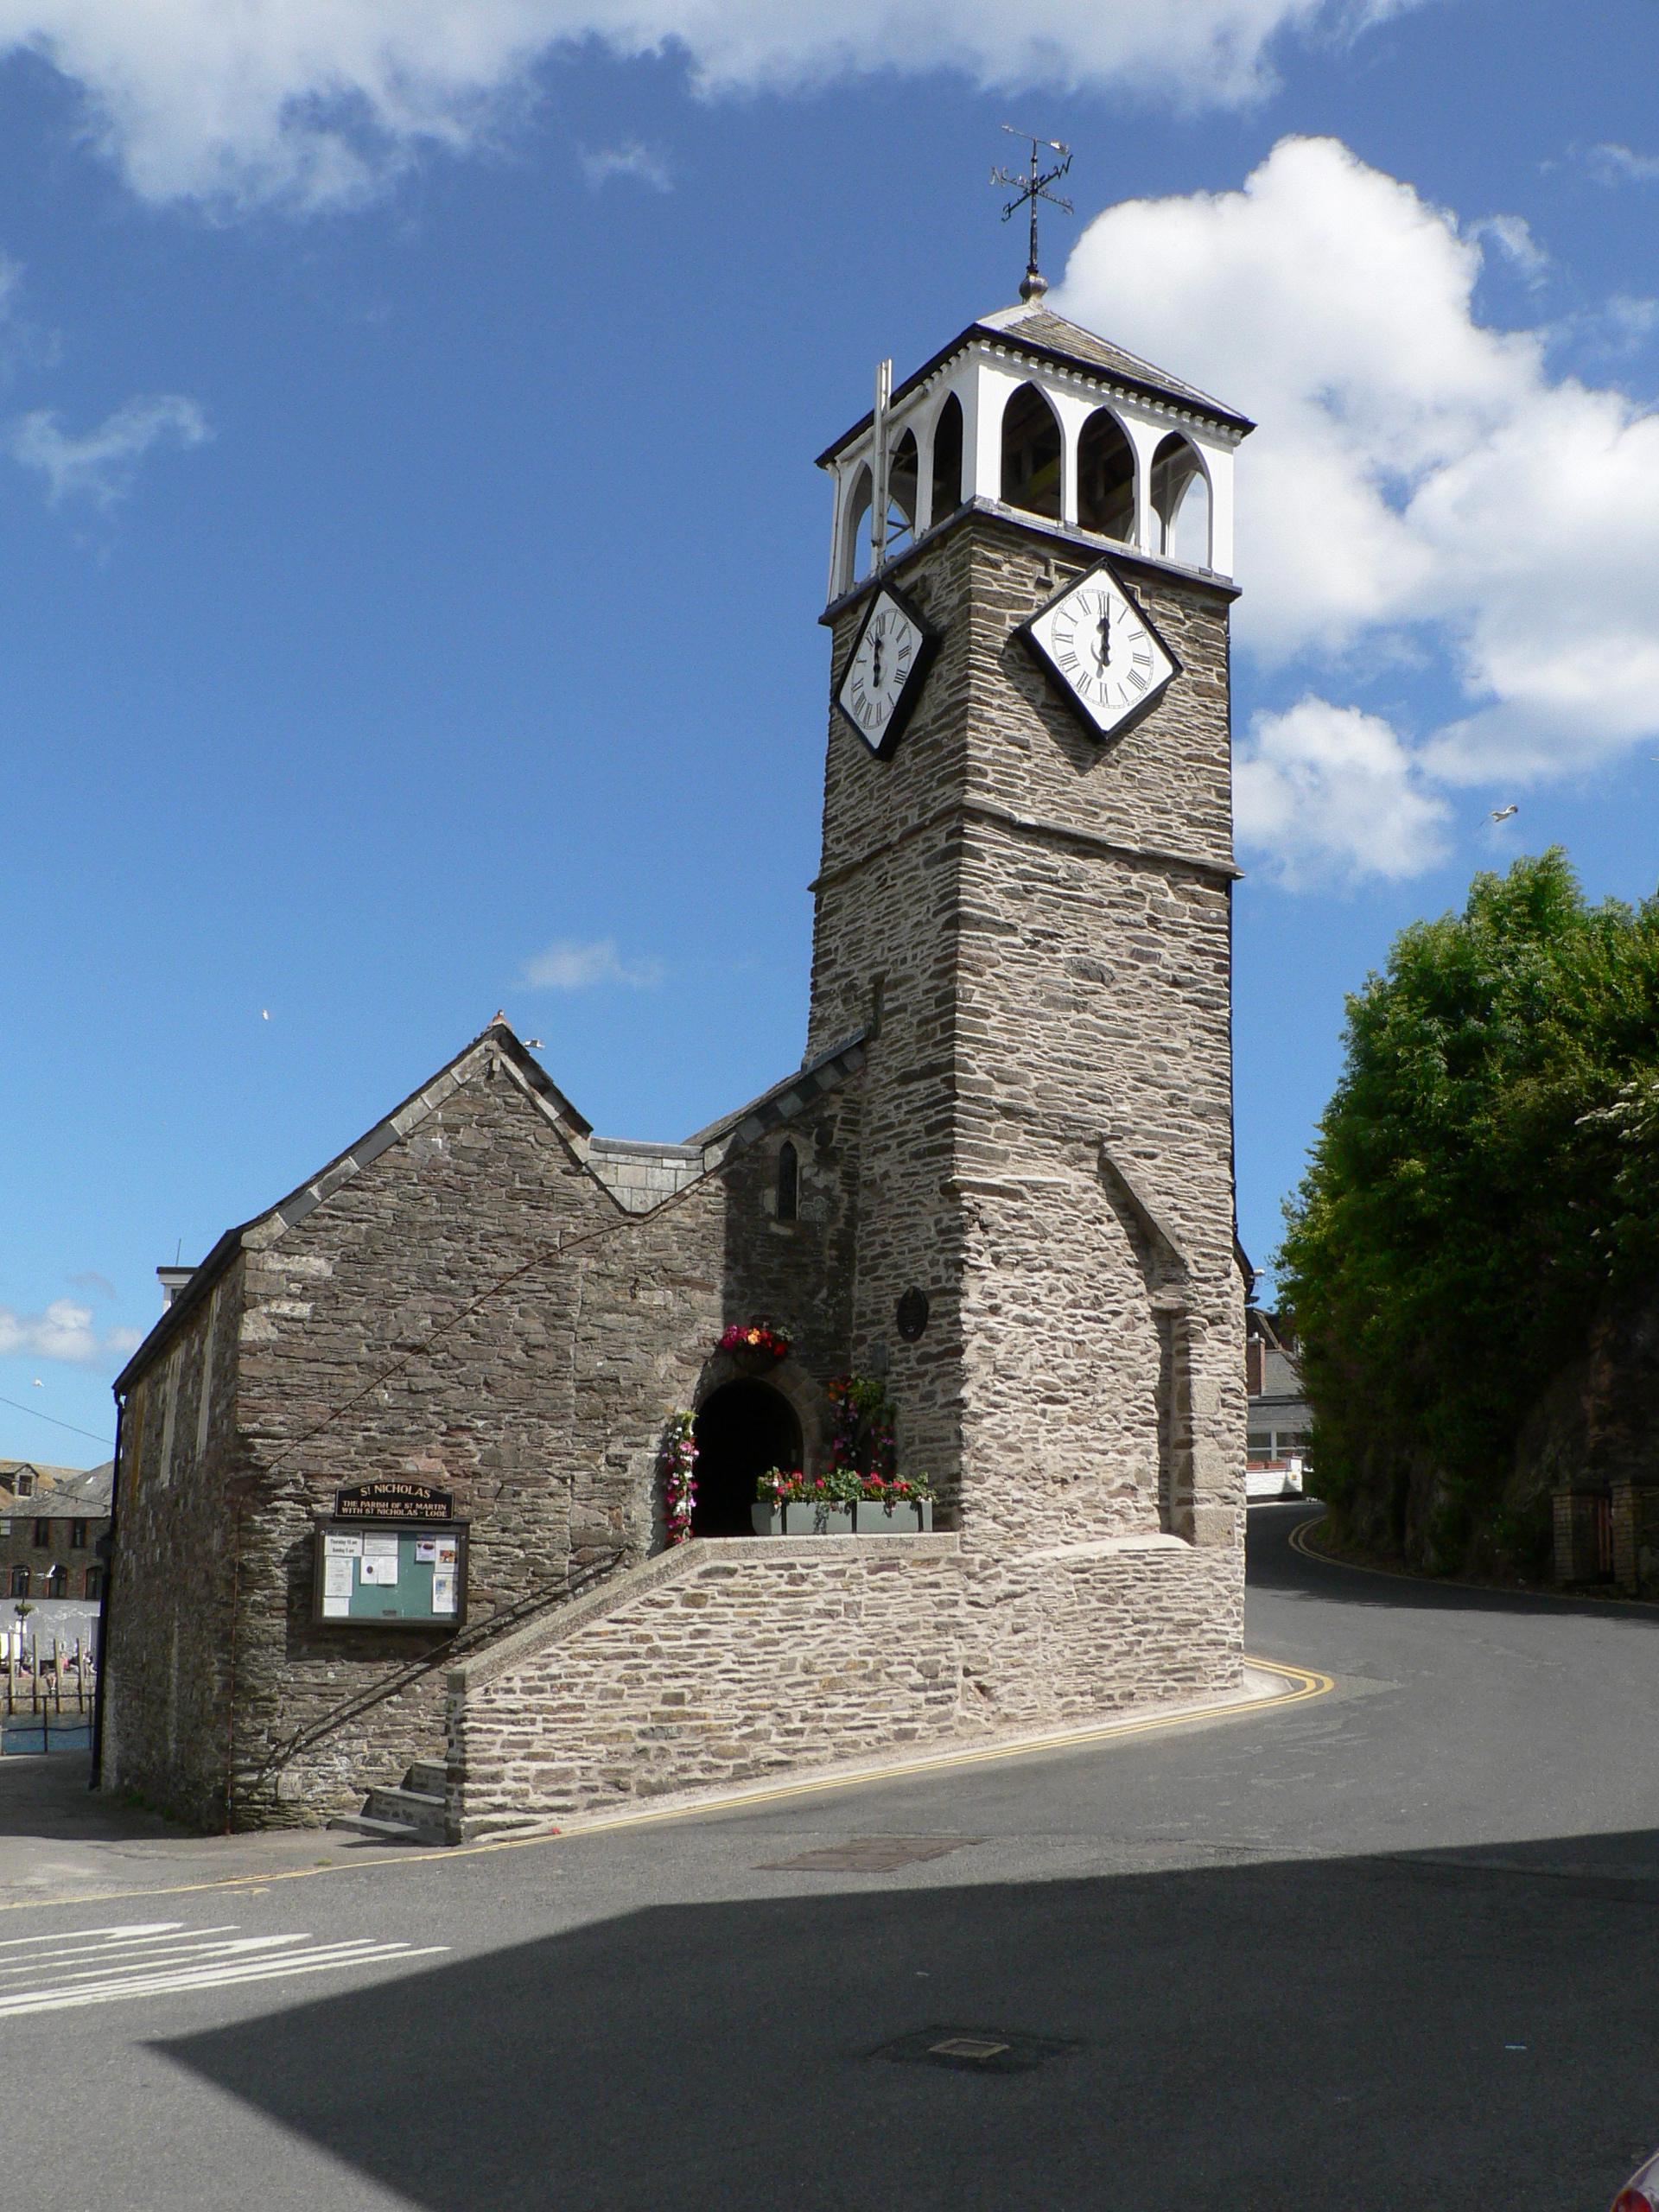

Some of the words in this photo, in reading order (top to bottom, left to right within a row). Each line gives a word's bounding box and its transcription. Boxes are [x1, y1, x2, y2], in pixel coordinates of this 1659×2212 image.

[375, 1484, 430, 1498] NICHOLAS
[341, 1506, 363, 1515] WITH
[377, 1508, 418, 1516] NICHOLAS
[360, 1500, 389, 1509] PARISH
[415, 1503, 447, 1511] MARTIN
